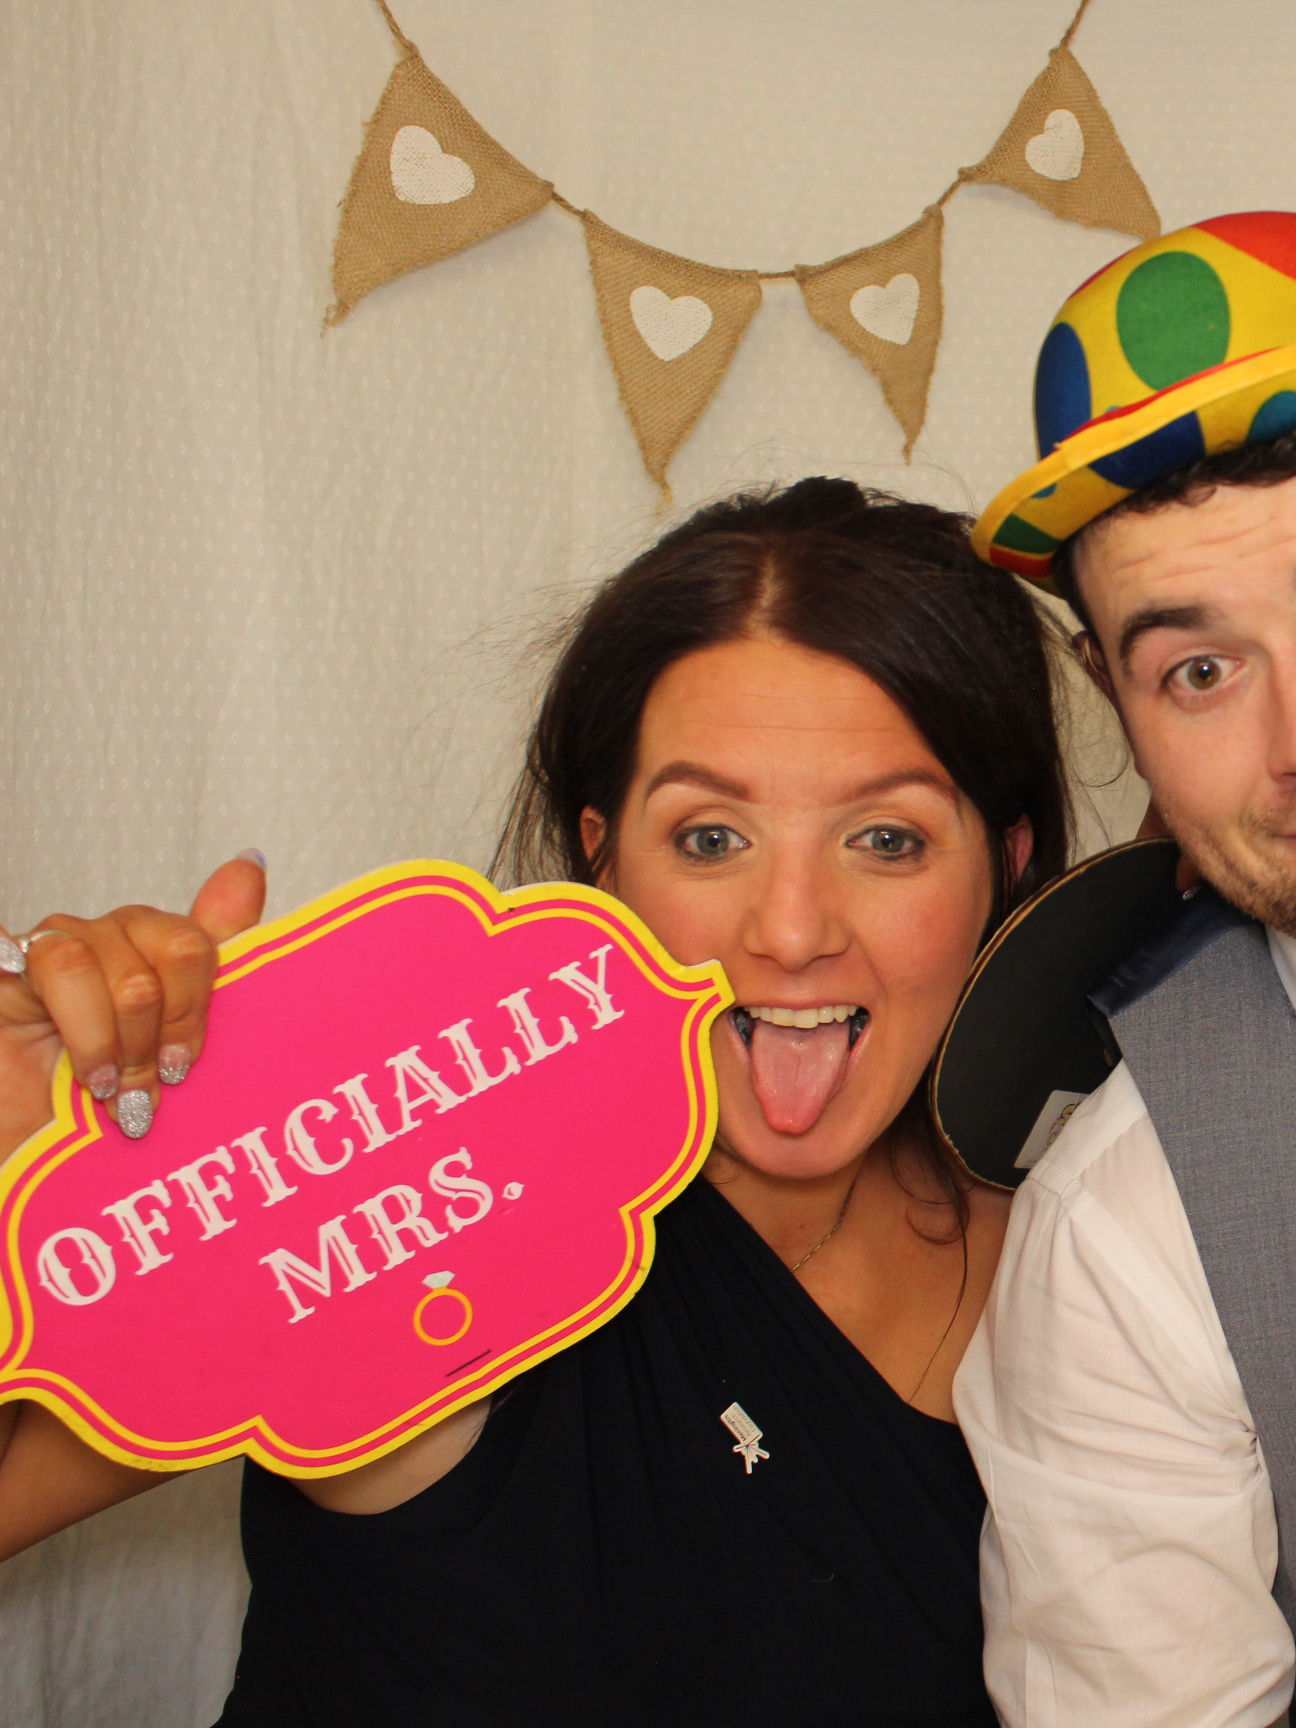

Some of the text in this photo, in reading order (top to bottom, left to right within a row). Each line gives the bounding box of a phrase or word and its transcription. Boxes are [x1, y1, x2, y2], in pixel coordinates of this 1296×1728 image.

[36, 943, 626, 1308] OFFICIALLY
[258, 1146, 526, 1325] MRS.
[725, 1414, 747, 1442] Meningitis
[732, 1404, 757, 1433] Foundation
